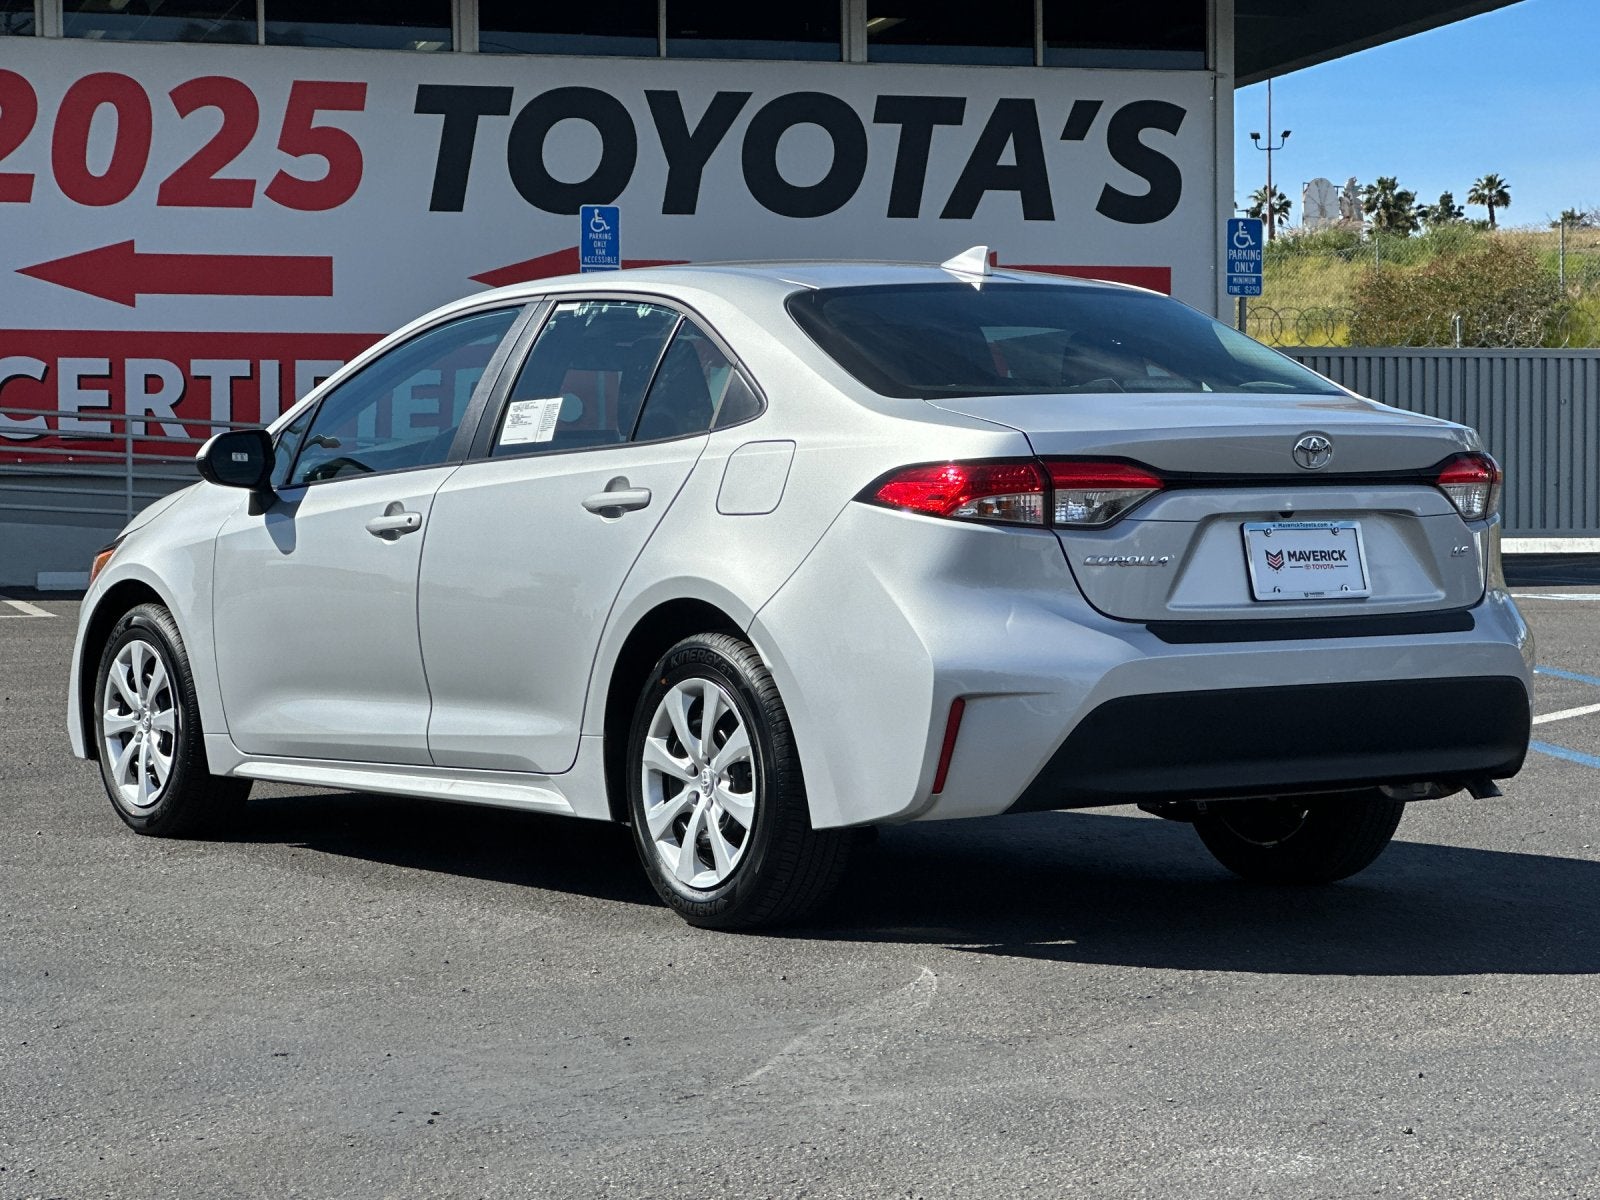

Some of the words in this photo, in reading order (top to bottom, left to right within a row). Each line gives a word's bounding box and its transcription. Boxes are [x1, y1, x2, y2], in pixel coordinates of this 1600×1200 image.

[414, 84, 1187, 224] TOYOTA'S
[588, 232, 612, 240] PARKING
[593, 240, 607, 248] ONLY
[583, 256, 617, 264] ACCESSIBLE
[1228, 249, 1261, 261] PARKING
[1234, 261, 1255, 273] ONLY
[1232, 276, 1257, 285] MINIMUM
[1228, 285, 1241, 293] FINE
[1244, 285, 1260, 294] $250
[1083, 554, 1172, 567] COROLLA
[1287, 549, 1348, 562] MAVERICK
